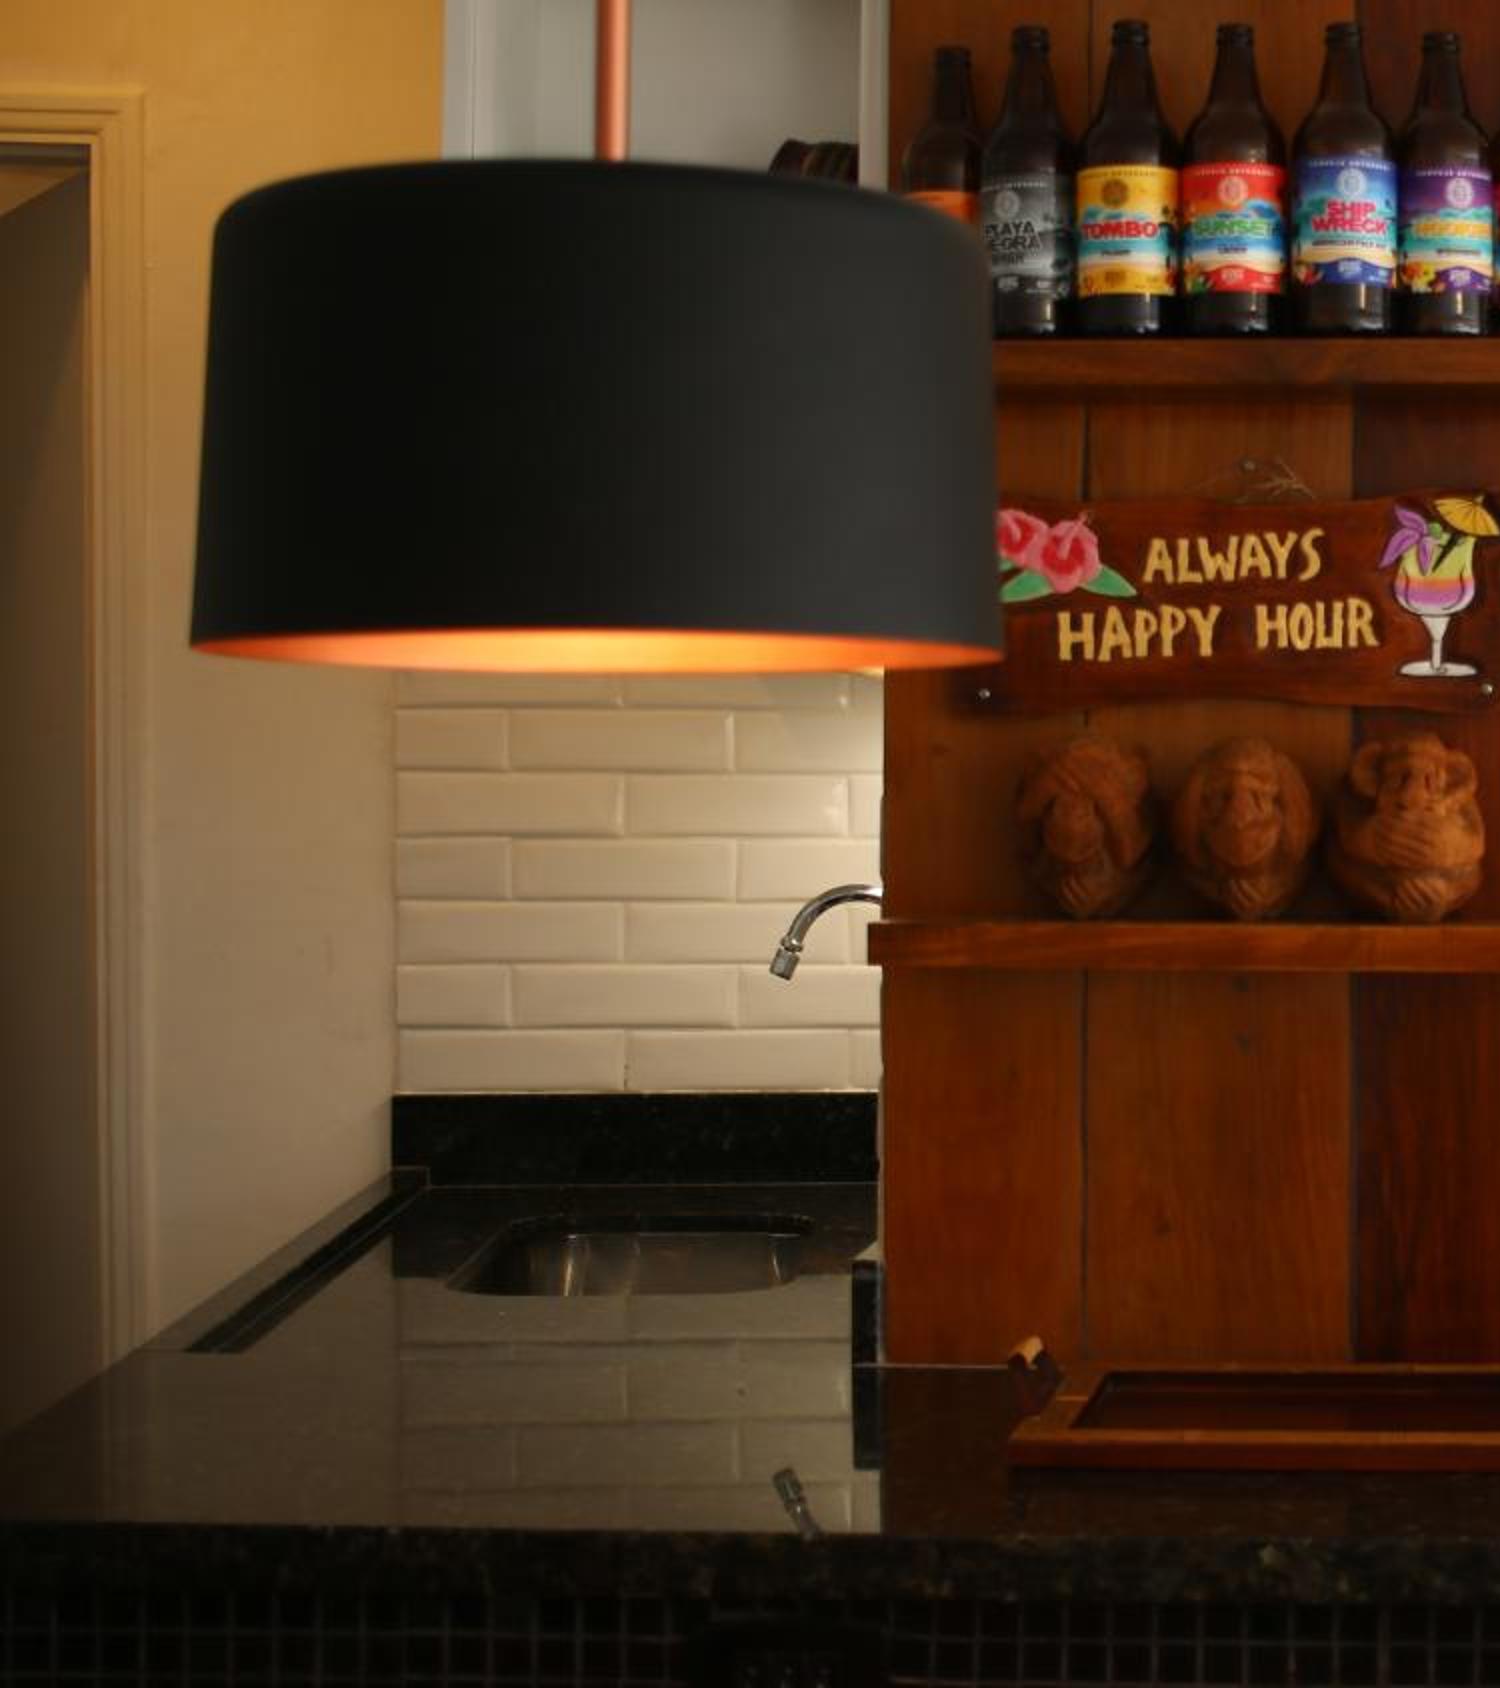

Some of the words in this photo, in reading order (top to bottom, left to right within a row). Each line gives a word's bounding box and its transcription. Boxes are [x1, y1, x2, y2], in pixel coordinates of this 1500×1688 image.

[1328, 199, 1377, 219] SHIP
[1081, 219, 1158, 239] TOMBO
[1311, 217, 1388, 235] WRECK
[1143, 528, 1325, 585] ALWAYS
[1057, 604, 1221, 662] HAPPY
[1255, 597, 1380, 651] HOUR
